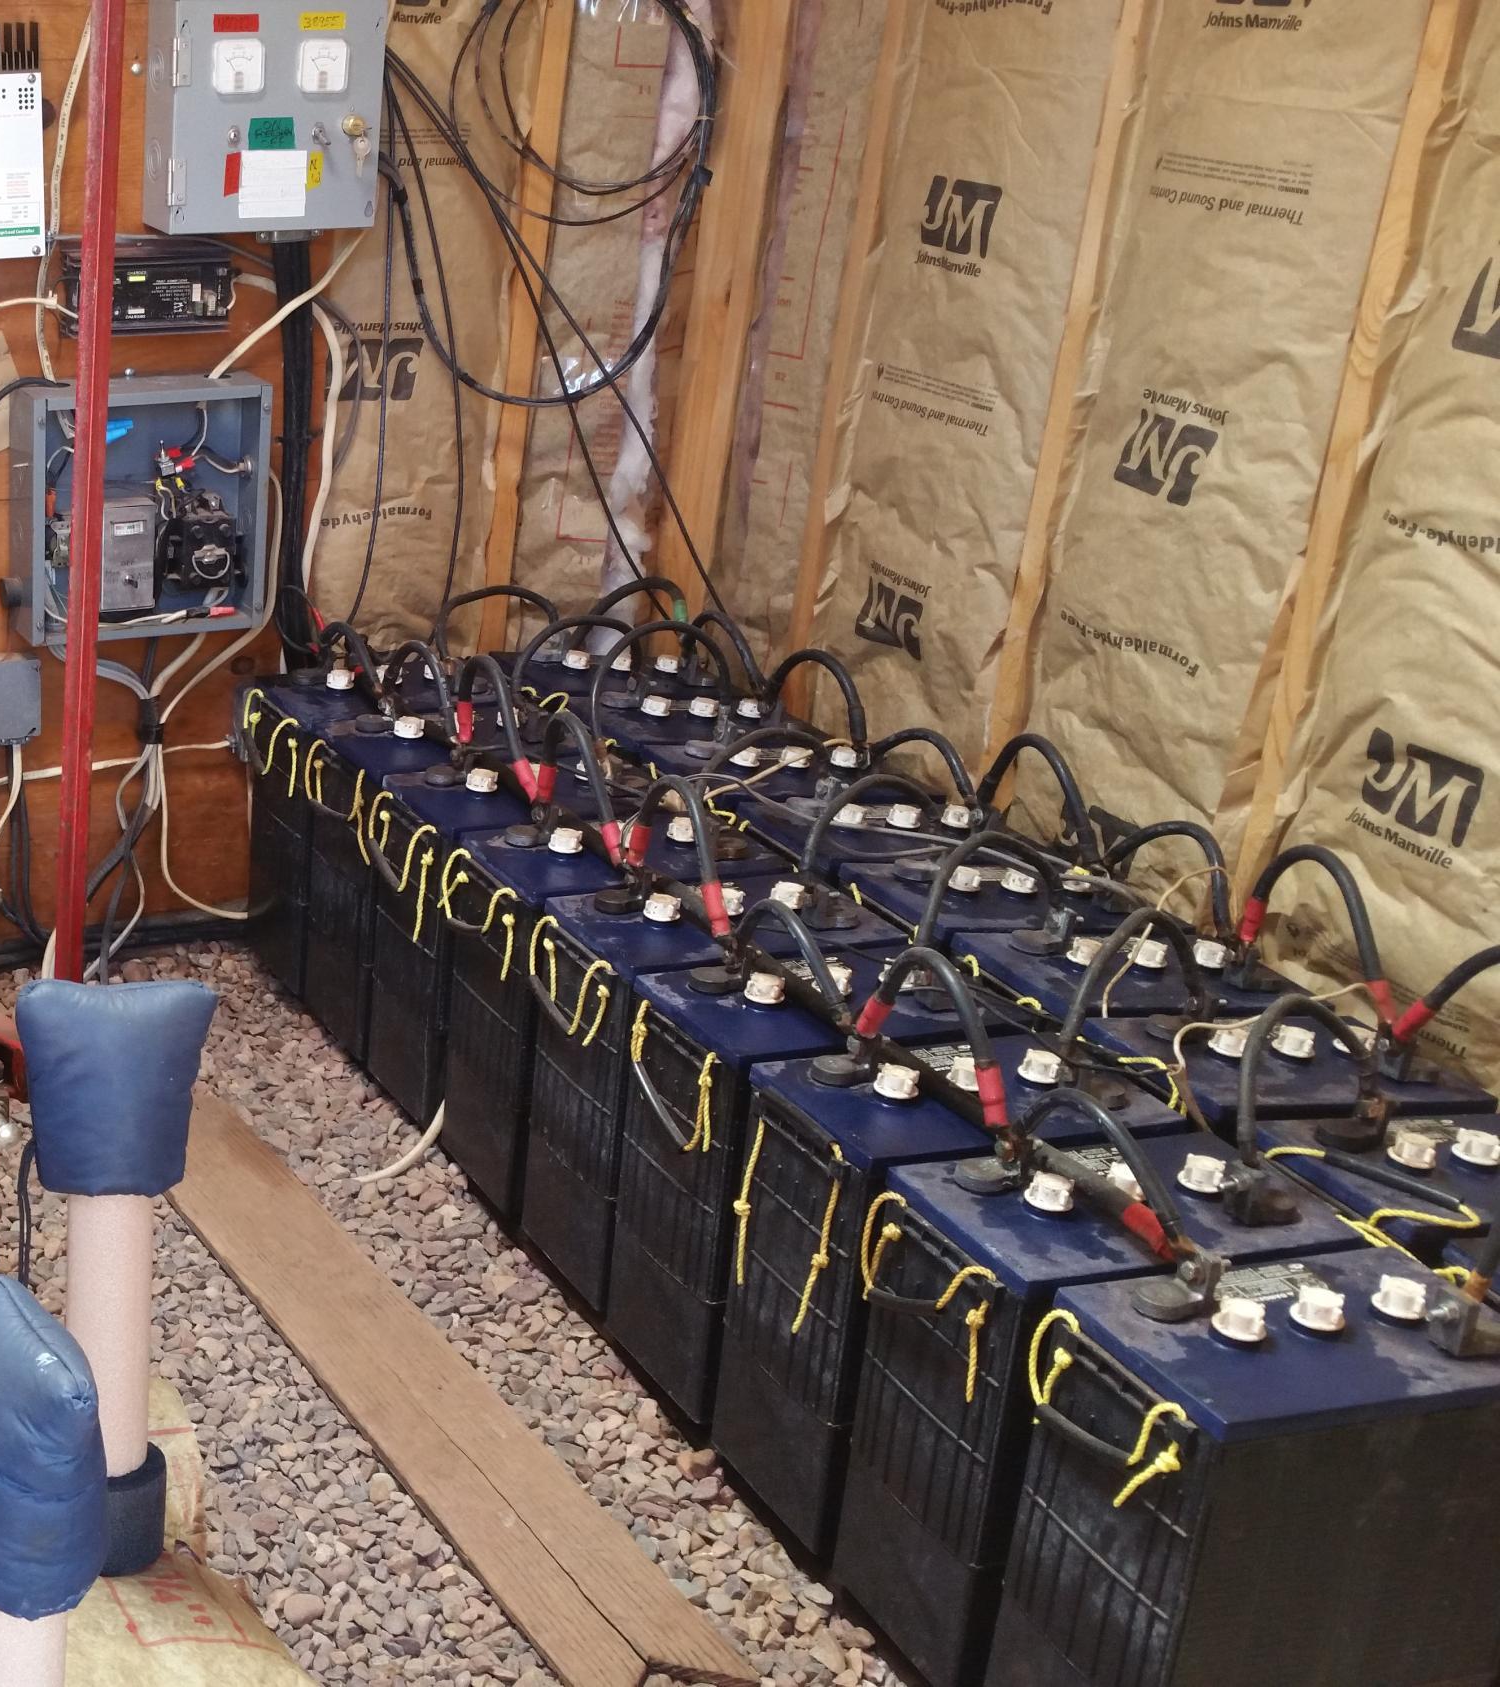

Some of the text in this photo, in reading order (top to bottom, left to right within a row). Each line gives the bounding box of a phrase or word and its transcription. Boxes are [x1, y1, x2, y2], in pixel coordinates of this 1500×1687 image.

[1203, 11, 1302, 31] Johns Manville
[1179, 191, 1217, 211] Sound
[1219, 198, 1245, 212] and
[921, 175, 1002, 259] JM
[1247, 202, 1304, 226] Thermal
[901, 401, 926, 419] Sound
[927, 408, 946, 424] and
[1191, 401, 1229, 426] Johns
[946, 416, 988, 437] Thermal
[320, 506, 432, 530] Formalehyde
[1362, 727, 1485, 849] JM
[1346, 806, 1454, 871] Johns Manville
